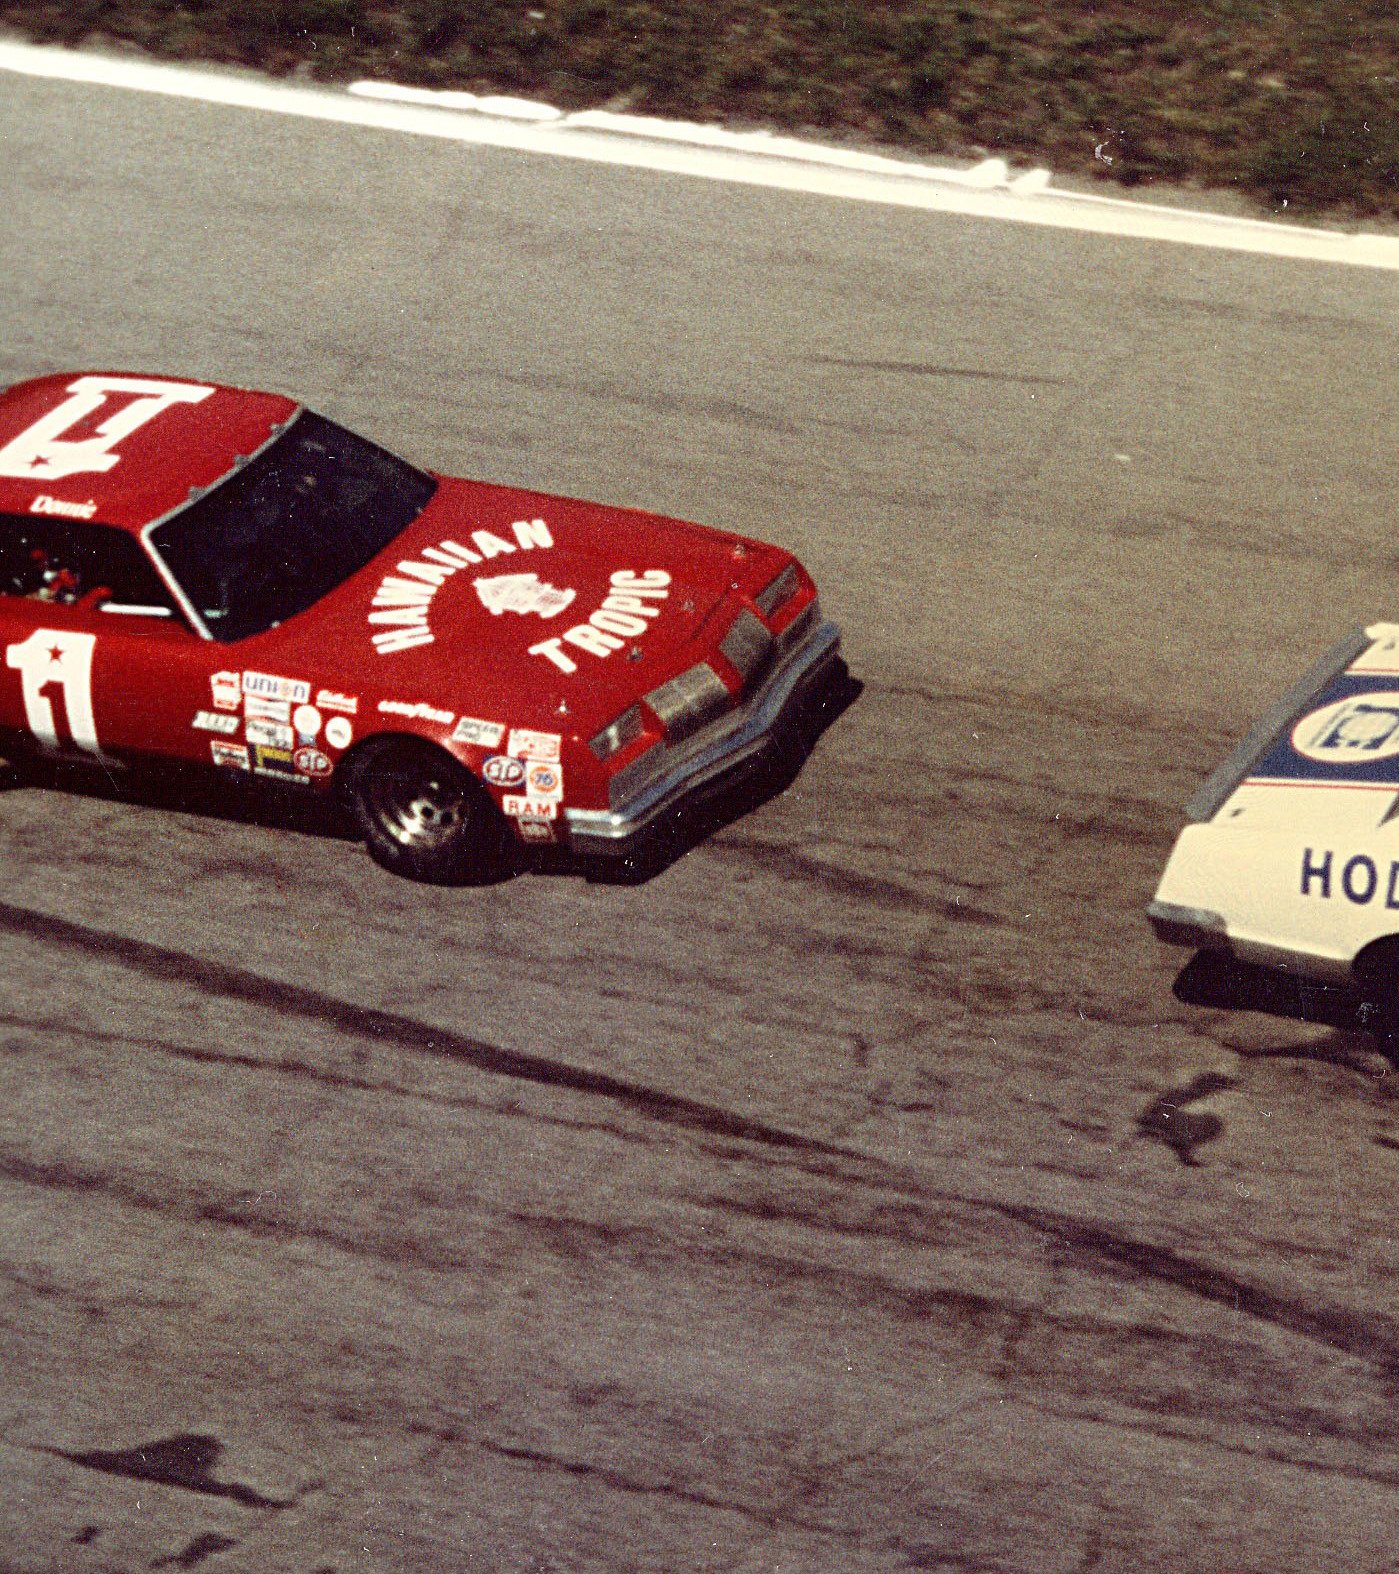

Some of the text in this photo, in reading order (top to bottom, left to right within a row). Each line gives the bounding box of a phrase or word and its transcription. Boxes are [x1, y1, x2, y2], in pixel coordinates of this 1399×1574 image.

[368, 519, 554, 655] HAWAIIAN
[529, 569, 673, 675] TROPIC
[7, 628, 100, 752] 11
[508, 799, 552, 818] RAM
